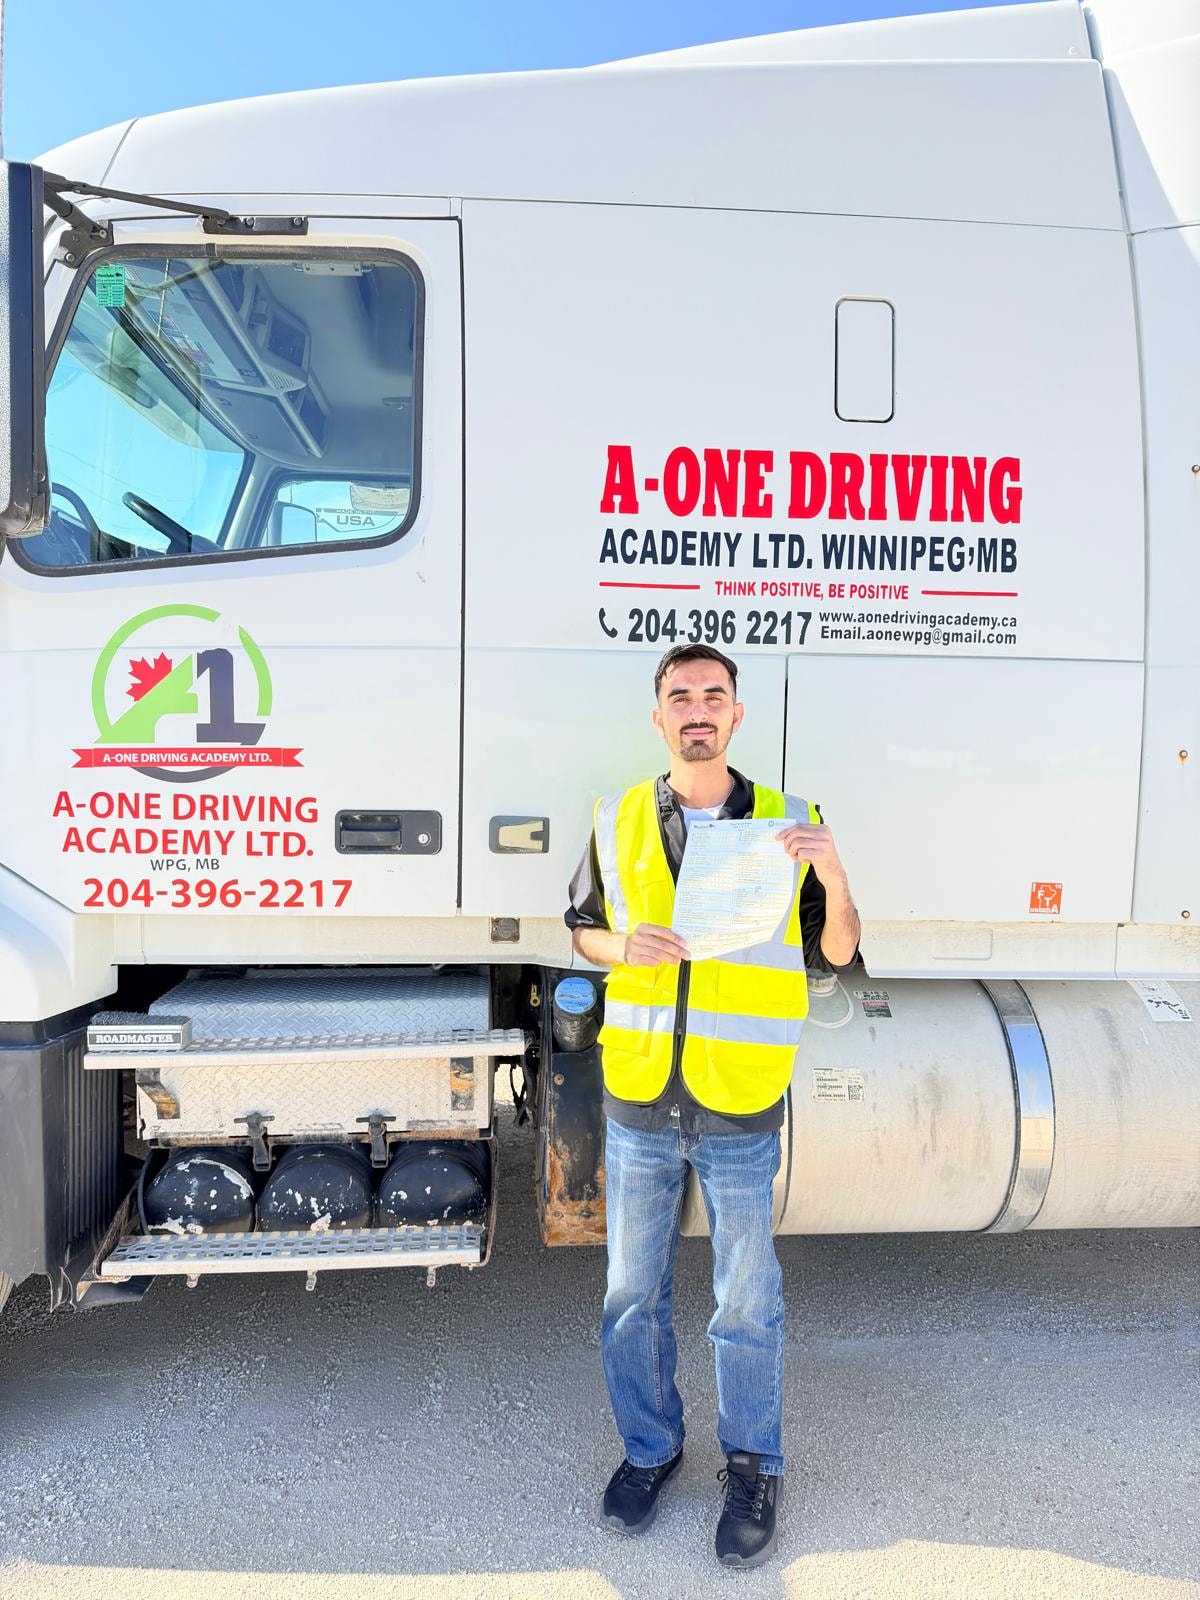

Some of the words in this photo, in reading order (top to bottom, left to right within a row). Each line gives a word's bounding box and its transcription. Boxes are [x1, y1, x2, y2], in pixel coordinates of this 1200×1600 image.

[600, 445, 774, 518] A-ONE
[788, 451, 1022, 524] DRIVING
[337, 515, 375, 526] USA
[600, 529, 742, 567] ACADEMY
[753, 534, 812, 568] LTD.
[715, 581, 756, 596] THINK
[760, 582, 824, 601] POSITIVE,
[829, 584, 844, 598] BE
[850, 584, 908, 600] POSITIVE
[628, 608, 736, 644] 204-396
[746, 611, 811, 644] 2217
[819, 610, 1017, 628] www.aonedrivingacademy.ca
[820, 625, 1017, 645] Email.aonewpg@gmail.com
[102, 752, 139, 763] A-ONE
[140, 752, 189, 763] DRIVING
[190, 752, 247, 763] ACADEMY
[248, 752, 273, 763] LTD.
[53, 791, 160, 819] A-ONE
[173, 794, 318, 823] DRIVING
[63, 827, 234, 855] ACADEMY
[246, 832, 313, 857] LTD.
[151, 859, 190, 872] WPG,
[196, 859, 219, 869] MB
[84, 878, 352, 908] 204-396-2217
[96, 1034, 174, 1043] ROADMASTER
